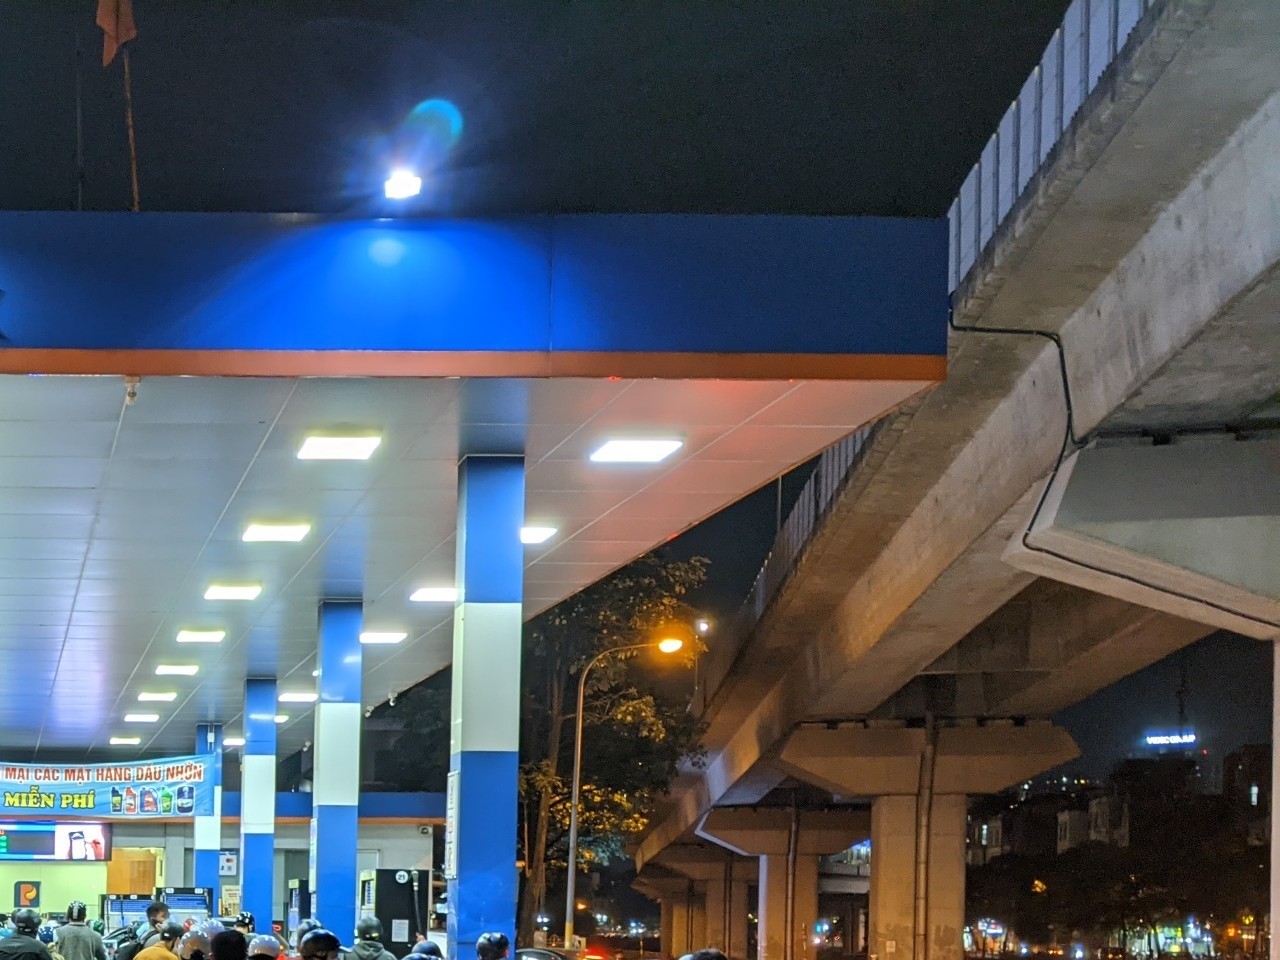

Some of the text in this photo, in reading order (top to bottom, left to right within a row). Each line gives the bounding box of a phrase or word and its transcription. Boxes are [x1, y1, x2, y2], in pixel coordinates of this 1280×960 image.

[5, 767, 30, 784] MẠI
[34, 765, 60, 781] CÁC
[96, 765, 132, 781] HÀNG
[4, 785, 55, 808] MIỄN
[60, 790, 96, 809] PHÍ
